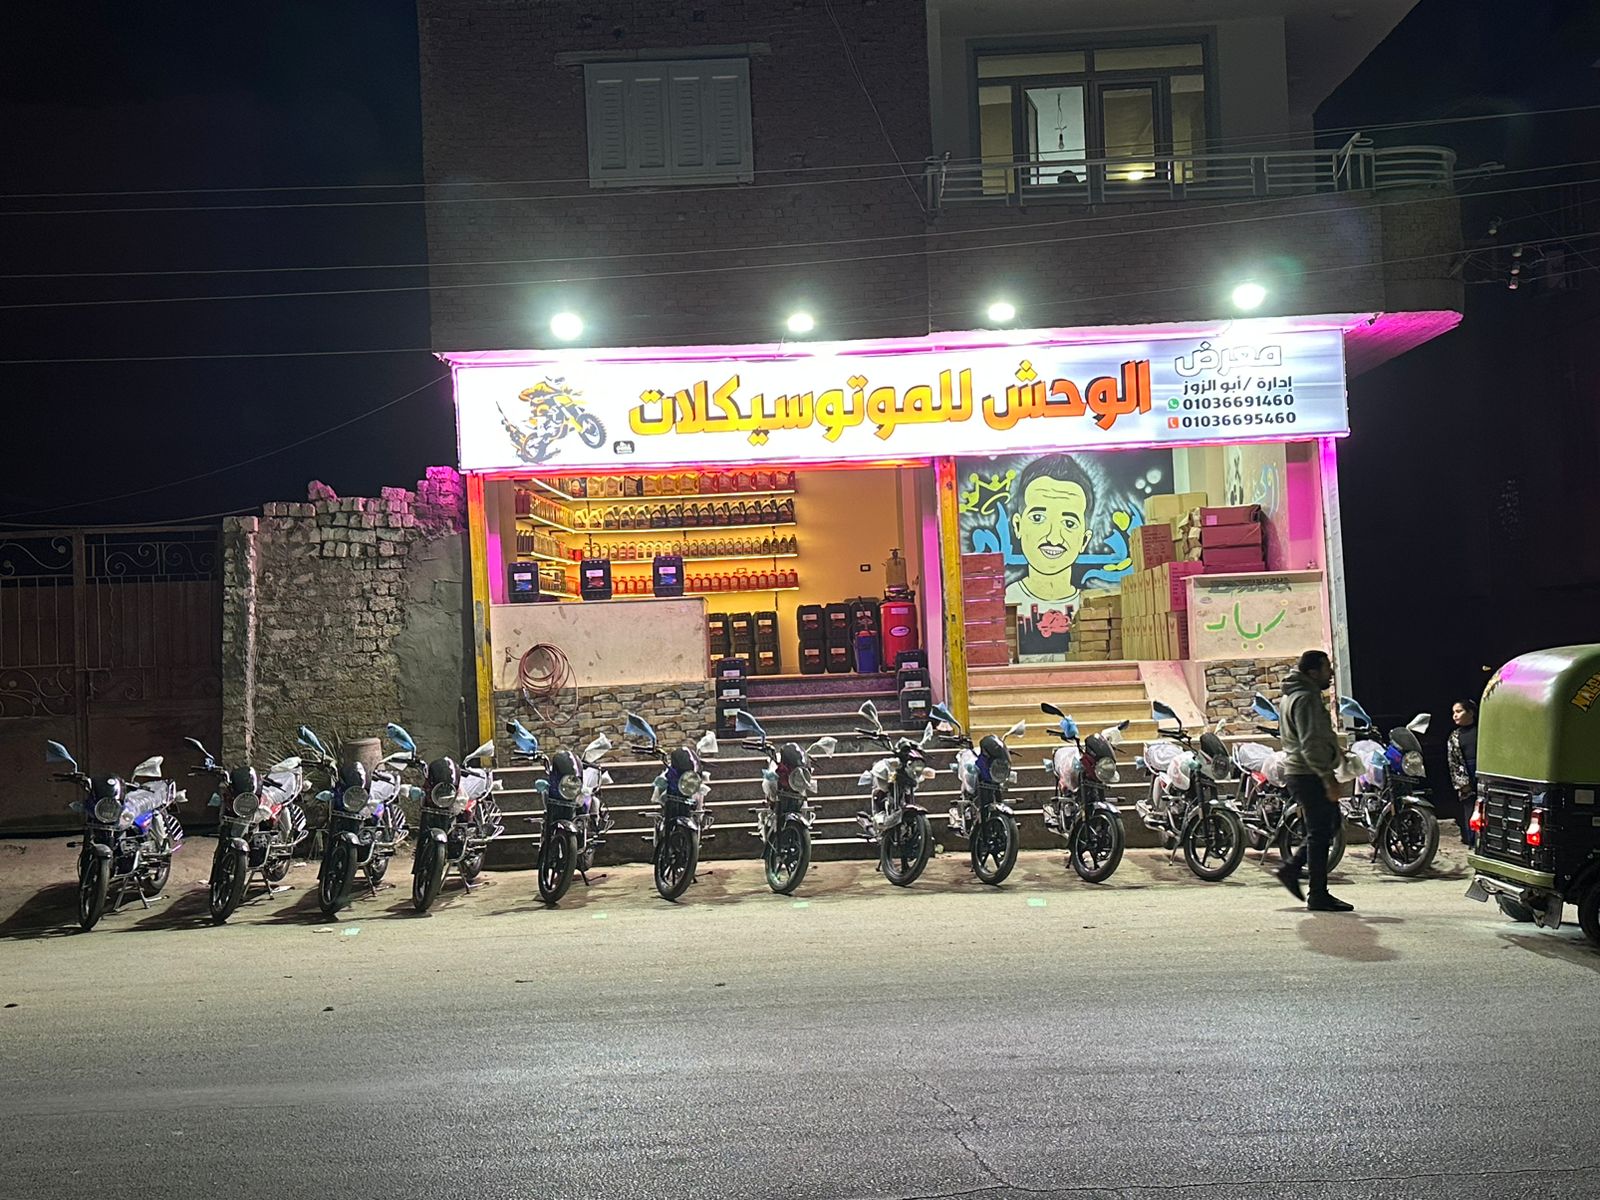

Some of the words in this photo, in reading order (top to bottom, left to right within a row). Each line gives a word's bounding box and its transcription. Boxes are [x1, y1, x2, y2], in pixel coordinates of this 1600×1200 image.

[1174, 340, 1282, 377] معرض
[982, 359, 1151, 431] الوحش
[1183, 379, 1216, 395] الزوز
[628, 367, 974, 447] للموتوسيكلات
[1183, 394, 1294, 410] 01036691460
[1182, 412, 1296, 428] 01036695460
